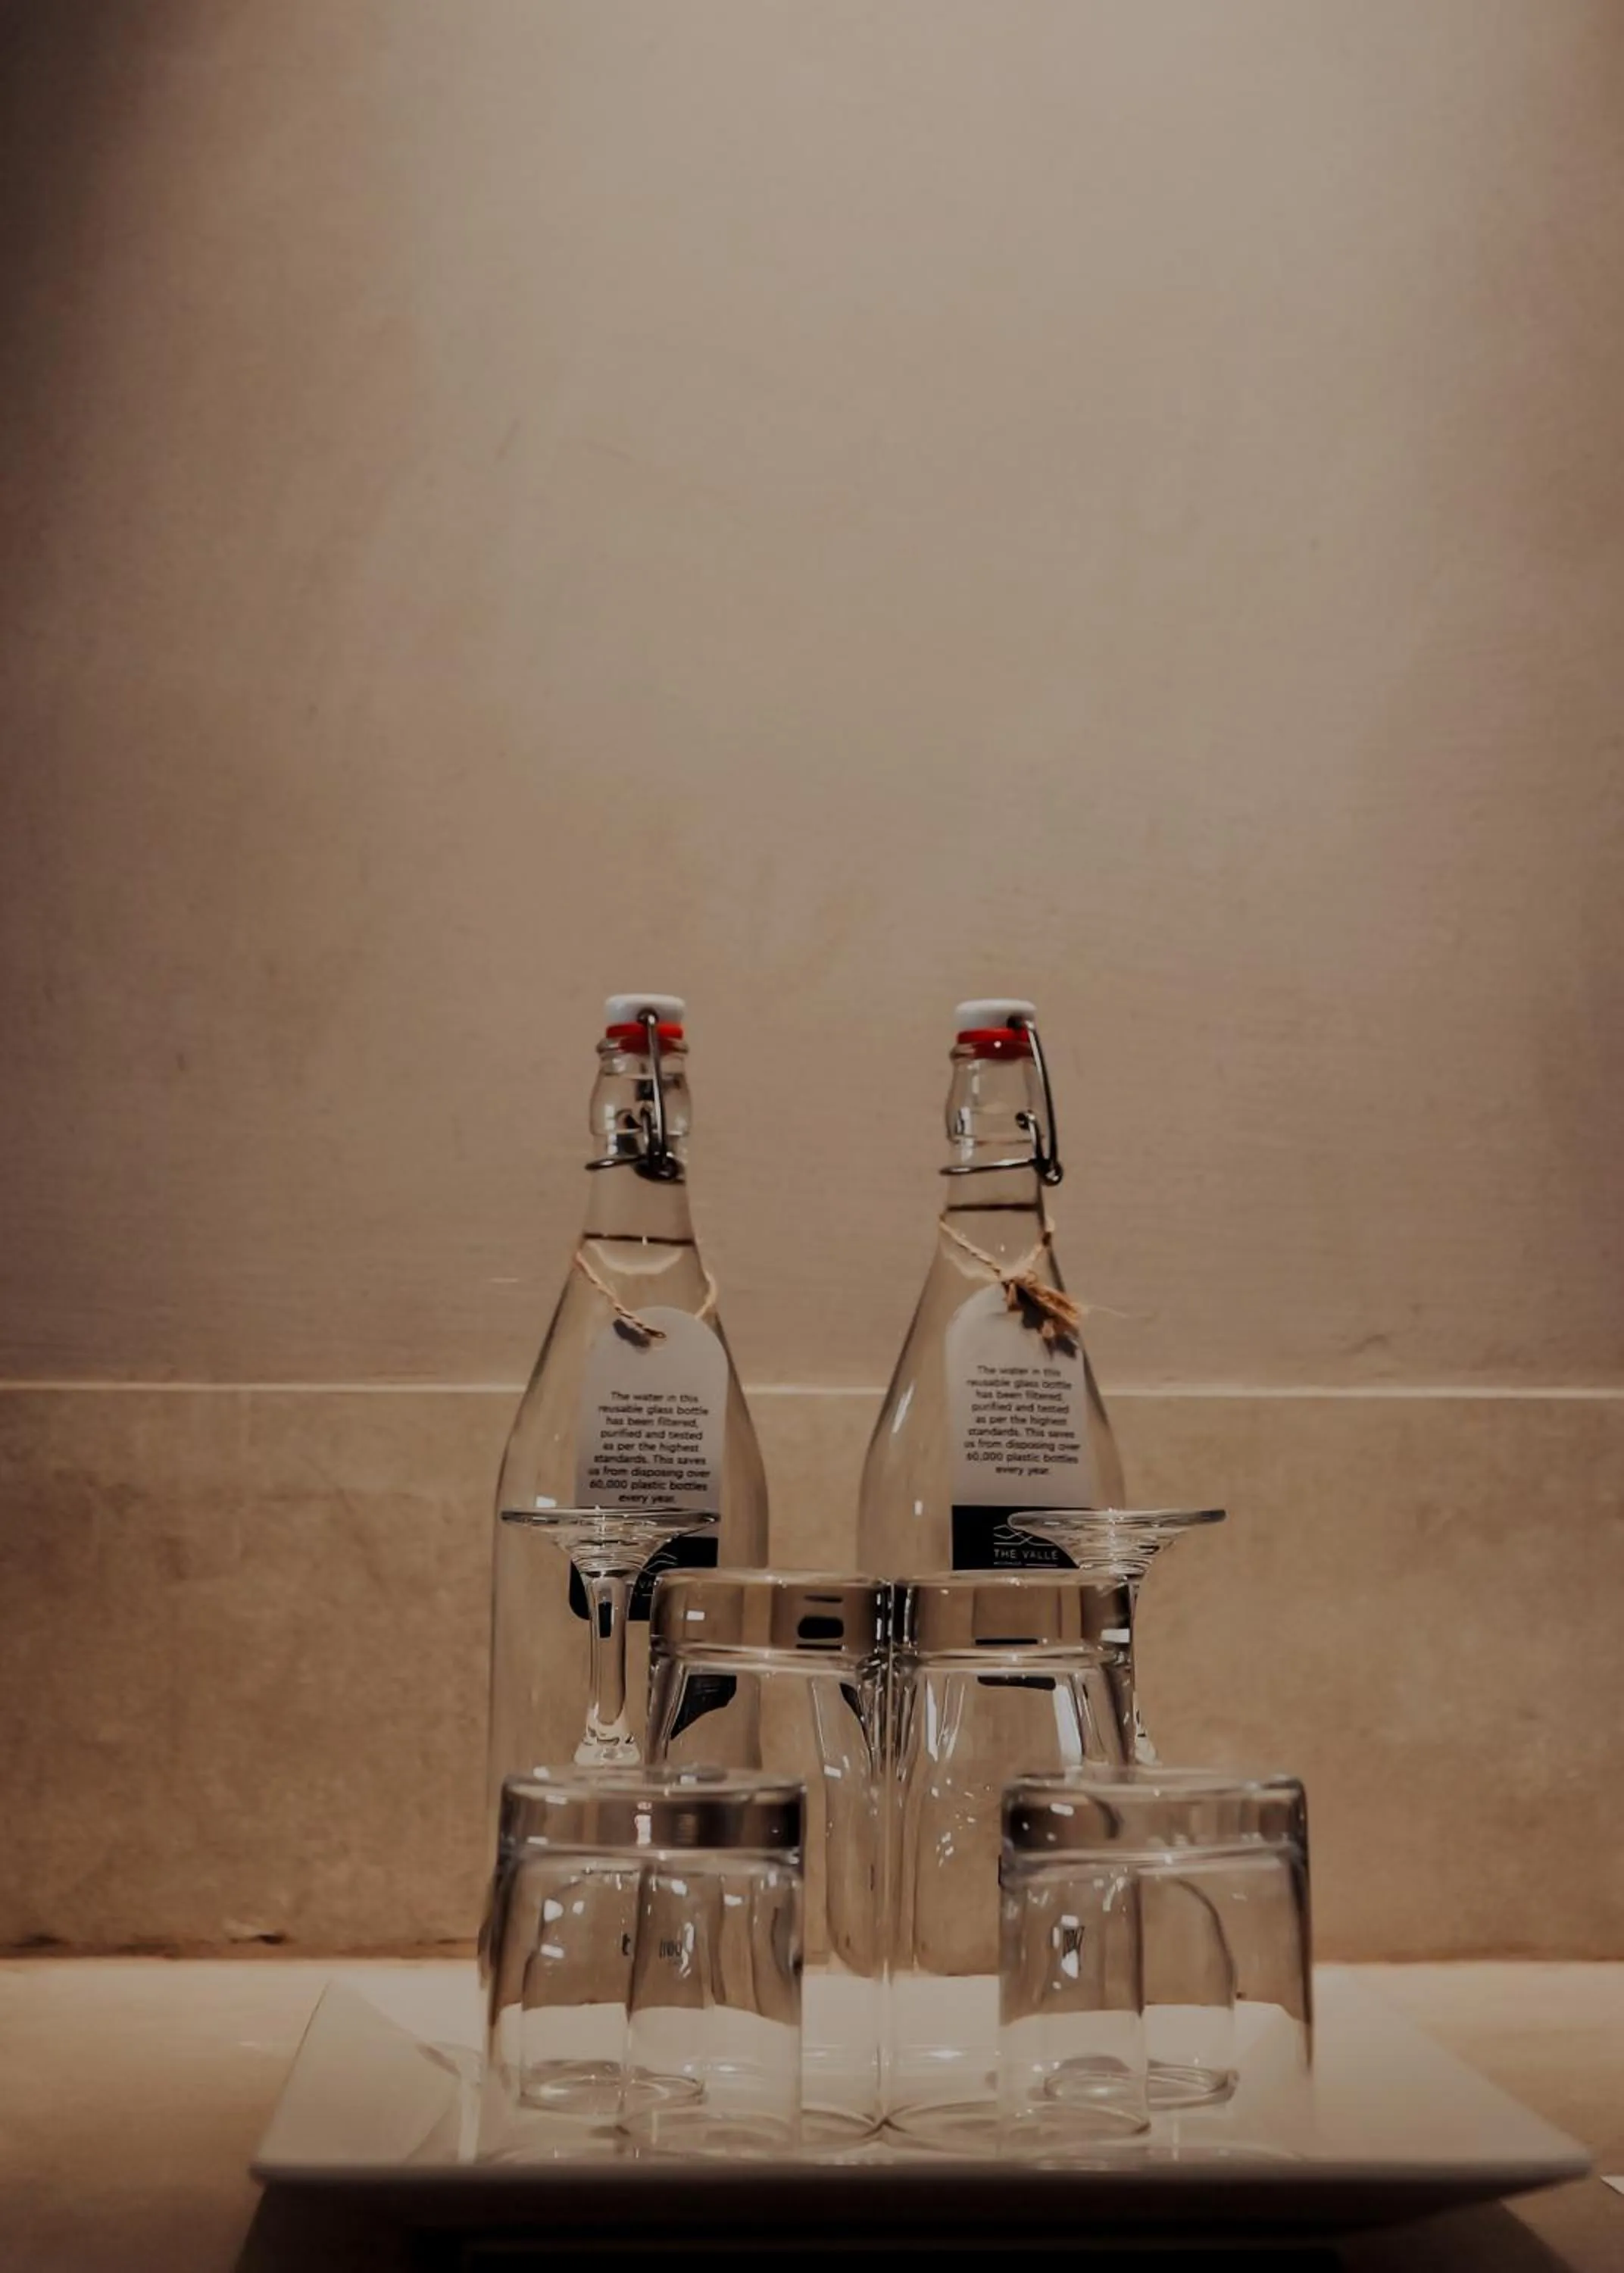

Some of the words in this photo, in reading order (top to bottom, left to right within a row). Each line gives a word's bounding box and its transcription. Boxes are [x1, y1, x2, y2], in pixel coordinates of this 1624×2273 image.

[611, 1391, 630, 1400] The
[679, 1394, 698, 1402] this
[647, 1405, 673, 1415] glass
[676, 1407, 709, 1415] bottle
[601, 1428, 642, 1439] purified
[645, 1430, 665, 1439] and
[669, 1431, 703, 1440] tested
[639, 1442, 656, 1451] the
[659, 1443, 699, 1453] highest
[653, 1455, 673, 1464] This
[603, 1466, 627, 1476] from
[631, 1467, 683, 1479] disposing
[686, 1469, 710, 1477] over
[631, 1480, 667, 1490] plastic
[669, 1480, 707, 1491] bottles
[619, 1495, 648, 1503] every
[994, 1549, 1016, 1559] THE
